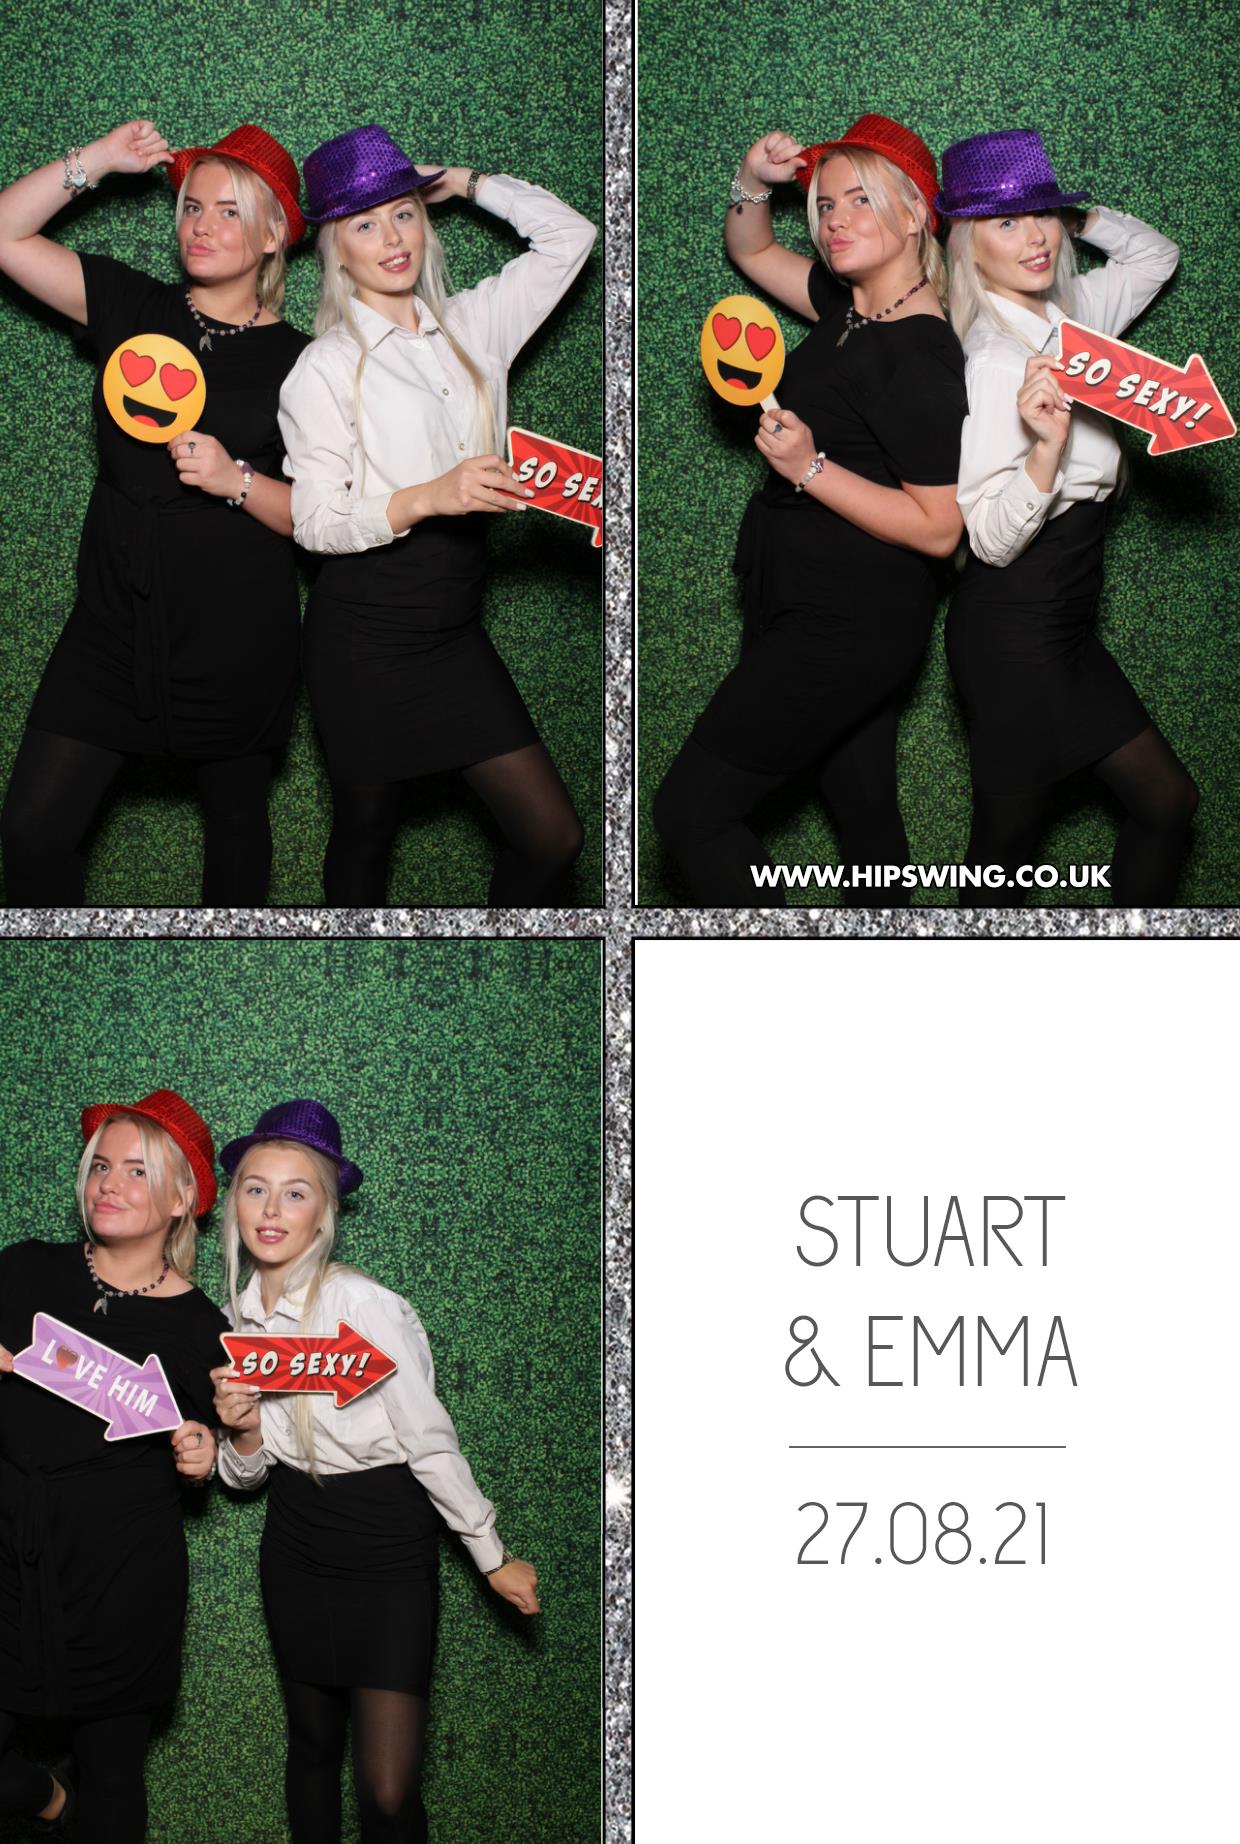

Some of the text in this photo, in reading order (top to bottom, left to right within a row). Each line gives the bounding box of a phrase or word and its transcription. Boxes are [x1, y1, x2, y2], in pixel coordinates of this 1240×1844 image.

[1065, 352, 1213, 429] SO SEXY!
[518, 456, 558, 489] SO
[242, 1351, 371, 1377] SO SEXY!
[107, 1375, 159, 1417] HIM
